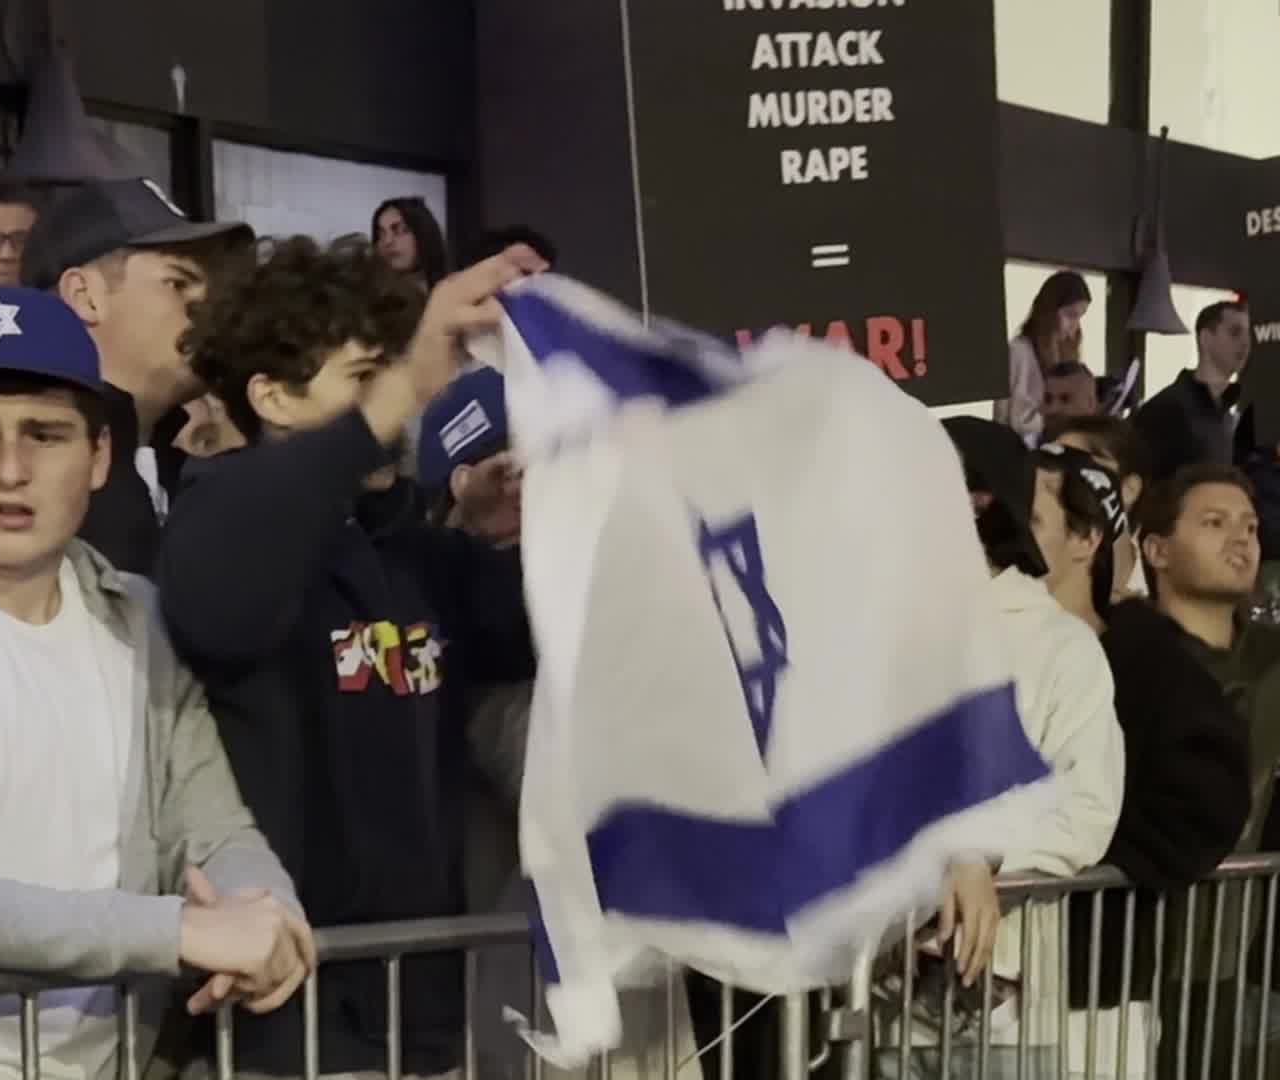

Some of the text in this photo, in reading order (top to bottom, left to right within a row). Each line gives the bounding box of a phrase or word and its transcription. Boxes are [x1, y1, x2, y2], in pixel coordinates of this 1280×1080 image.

[750, 29, 885, 70] ATTACK
[747, 87, 896, 128] MURDER
[780, 145, 869, 184] RAPE
